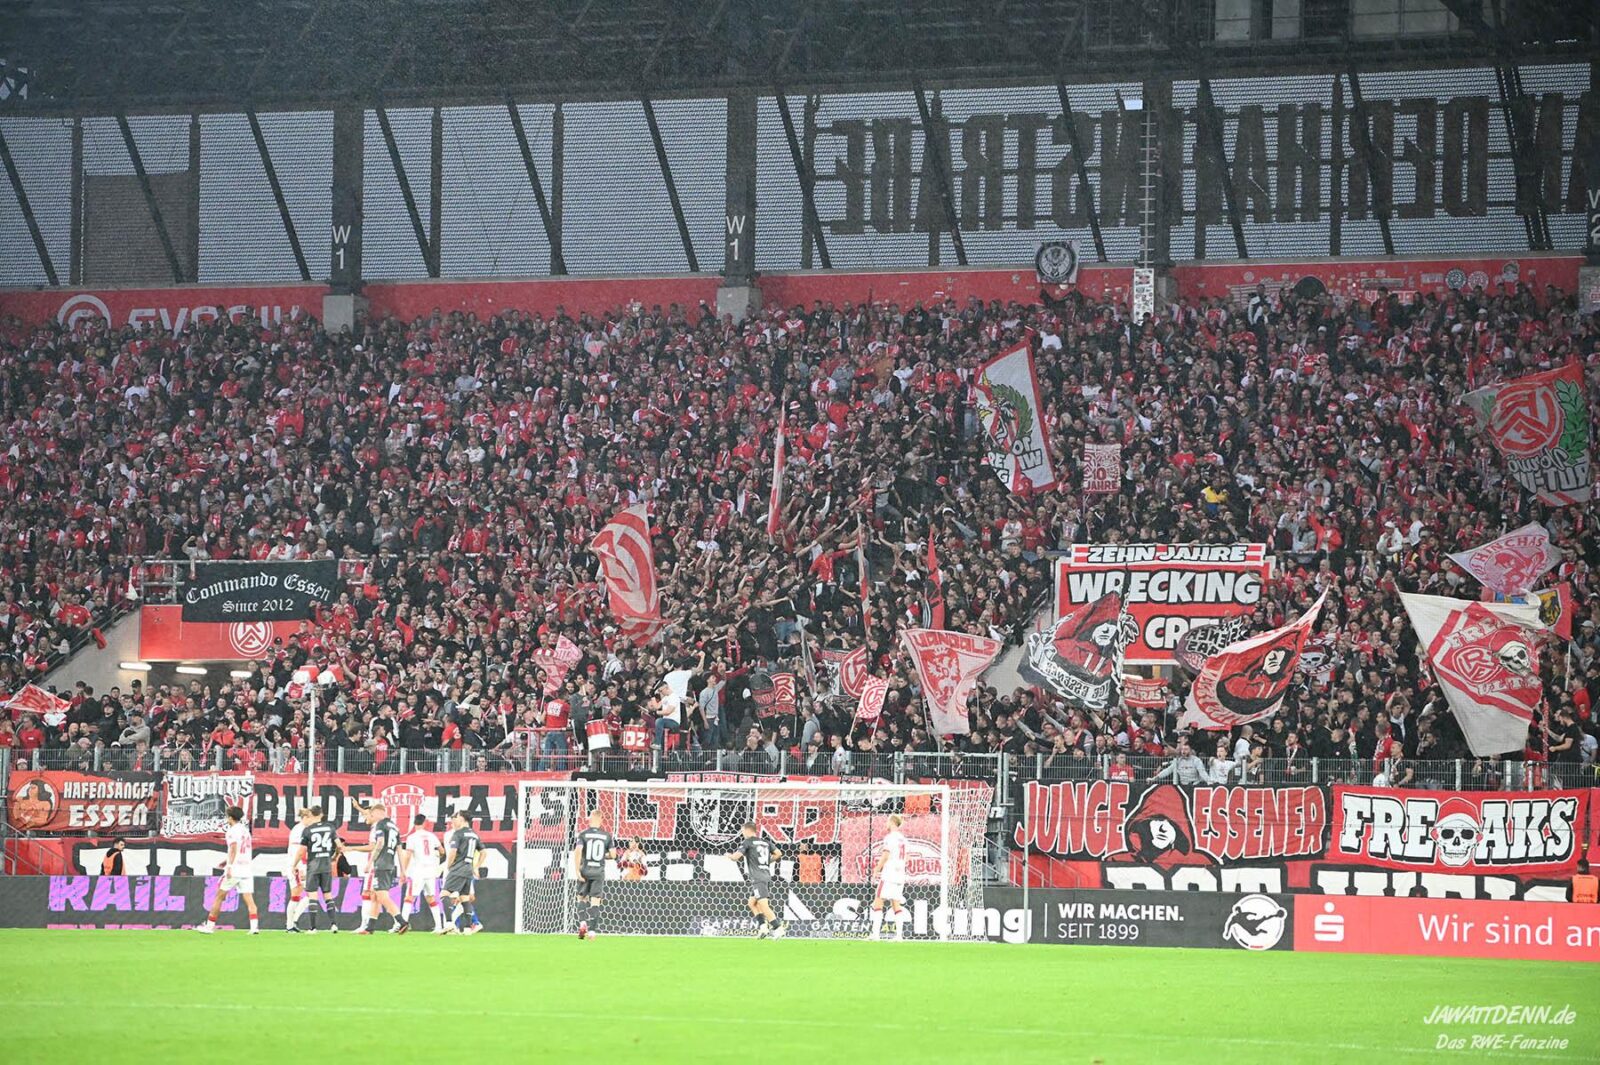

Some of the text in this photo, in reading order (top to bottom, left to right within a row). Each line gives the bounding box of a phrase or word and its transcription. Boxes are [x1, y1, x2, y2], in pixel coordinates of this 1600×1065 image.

[332, 225, 351, 244] W
[726, 215, 746, 234] W
[336, 248, 345, 269] 1
[730, 238, 738, 260] 1
[1087, 545, 1248, 563] ZEHN JAHRE
[186, 571, 331, 604] Commando Essen
[1068, 570, 1260, 604] WRECKING
[222, 598, 294, 613] Since 2012
[69, 804, 150, 827] ESSEN
[254, 784, 373, 832] RUDE
[1014, 780, 1326, 861] JUNGE ESSENER
[1340, 792, 1578, 866] FREAKS
[311, 831, 332, 852] 24
[586, 839, 605, 861] 10
[1058, 903, 1184, 921] WIR MACHEN.
[1058, 923, 1139, 940] SEIT 1899
[1418, 913, 1475, 941] Wir
[1485, 917, 1552, 945] sind
